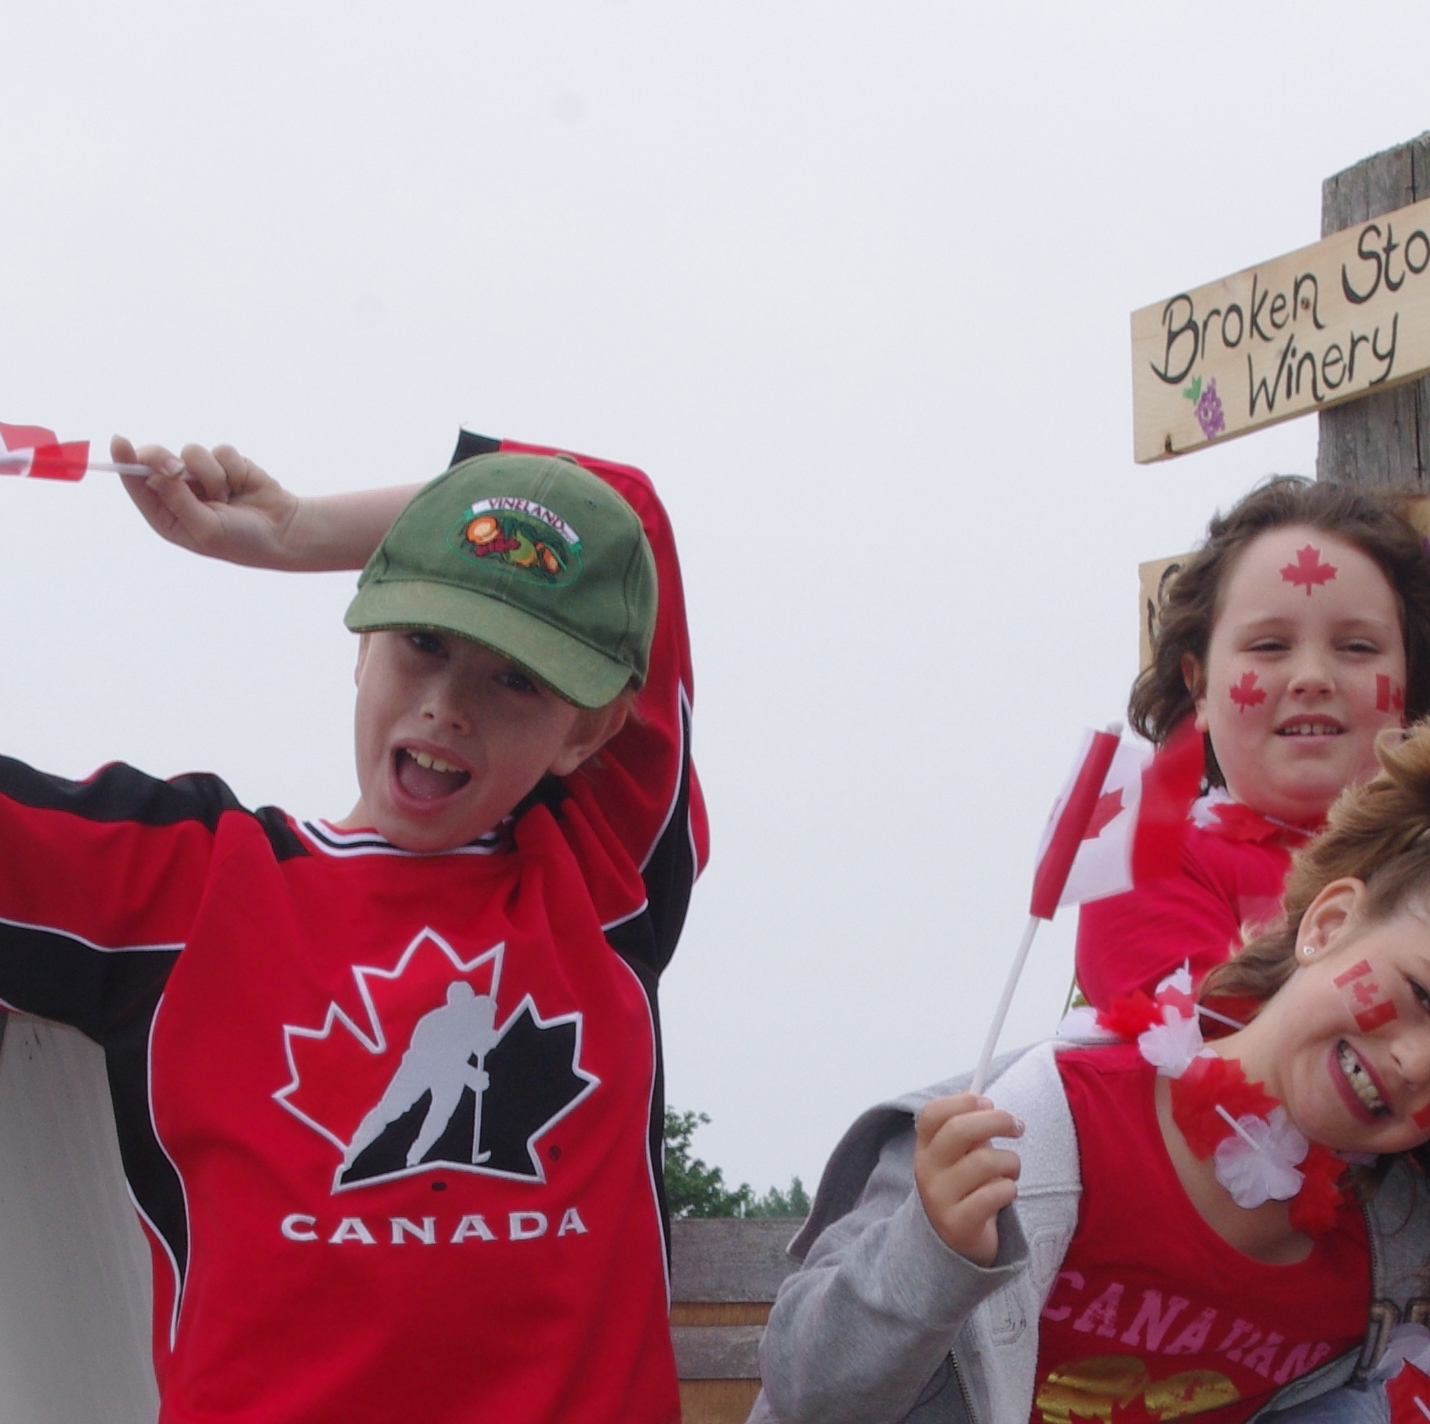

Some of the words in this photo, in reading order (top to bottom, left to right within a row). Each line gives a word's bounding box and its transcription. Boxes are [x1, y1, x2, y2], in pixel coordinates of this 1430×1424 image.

[1149, 273, 1326, 385] Broken
[1248, 312, 1400, 418] Winery
[488, 497, 566, 532] VINELAND
[280, 1206, 590, 1246] CANADA
